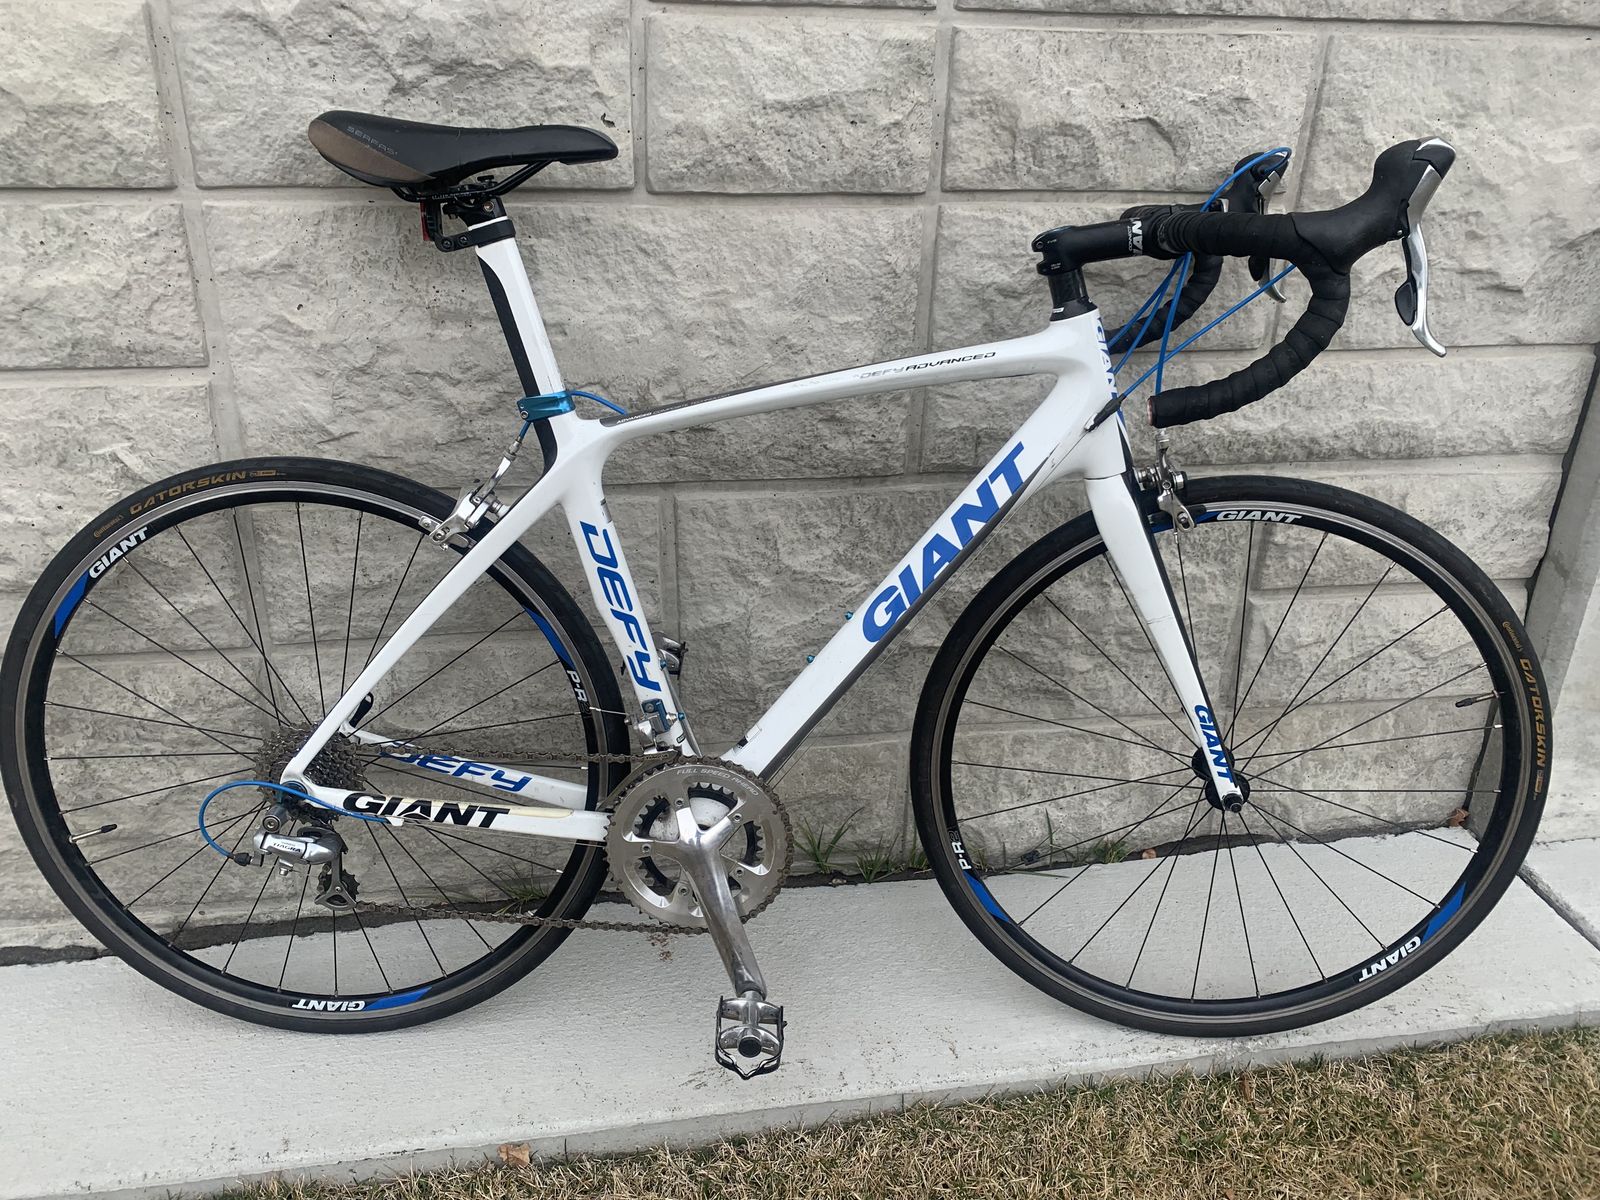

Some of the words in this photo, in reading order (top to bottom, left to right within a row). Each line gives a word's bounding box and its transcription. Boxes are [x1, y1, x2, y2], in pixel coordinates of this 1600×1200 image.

[905, 351, 996, 372] ADVANCED
[129, 470, 247, 516] GATORSKIN
[1216, 510, 1303, 525] GIANT
[88, 526, 148, 580] GIANT
[862, 441, 1025, 643] GIANT
[579, 520, 662, 692] DEFY
[1519, 657, 1547, 768] GATORSKIN
[1194, 704, 1234, 784] GIANT
[343, 791, 510, 829] GIANT
[1358, 936, 1422, 982] GIANT
[292, 998, 366, 1013] GIANT
